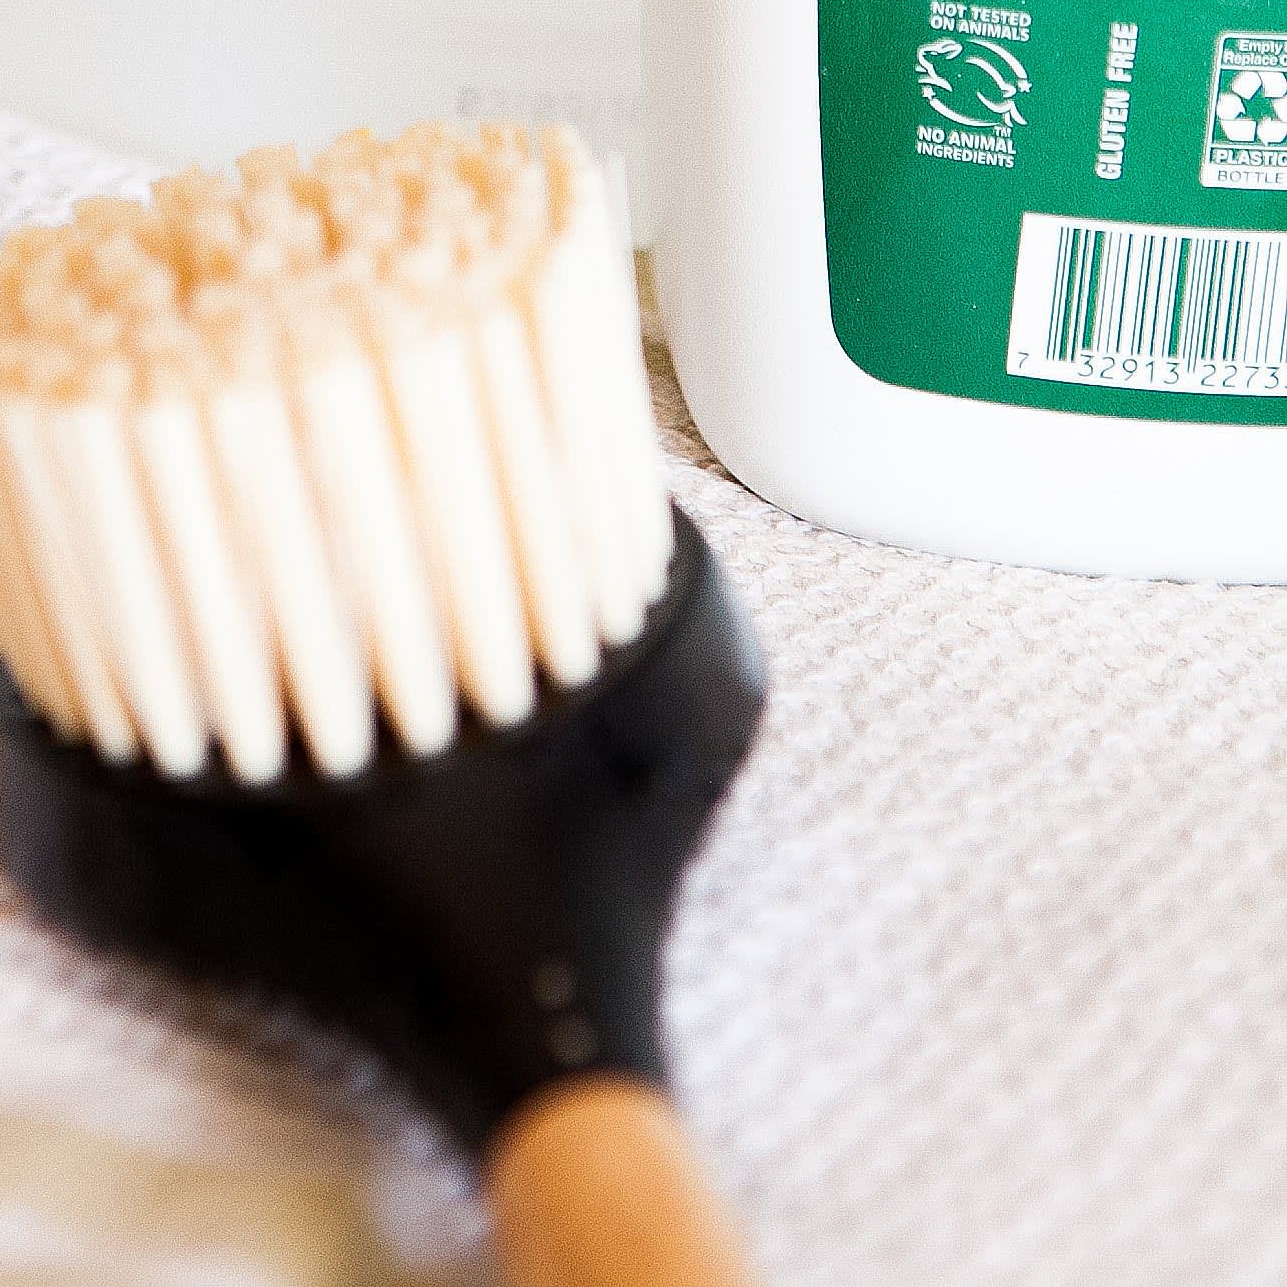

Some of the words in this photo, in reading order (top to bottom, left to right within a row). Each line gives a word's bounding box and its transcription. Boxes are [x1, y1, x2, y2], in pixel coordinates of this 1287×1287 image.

[931, 0, 967, 20] NOT
[969, 5, 1032, 27] TESTED
[930, 14, 956, 32] ON
[957, 19, 1031, 43] ANIMALS
[1109, 23, 1138, 82] FREE
[1225, 52, 1278, 67] Replace
[917, 125, 945, 144] NO
[948, 131, 1017, 155] ANIMAL
[994, 126, 1013, 138] TM
[1095, 89, 1131, 180] GLUTEN
[917, 141, 1015, 168] INGREDIENTS
[1216, 149, 1287, 167] PLASTIC
[1218, 170, 1284, 184] BOTTLE
[1017, 352, 1029, 368] 7
[1077, 354, 1180, 384] 32913
[1201, 364, 1287, 389] 2273
